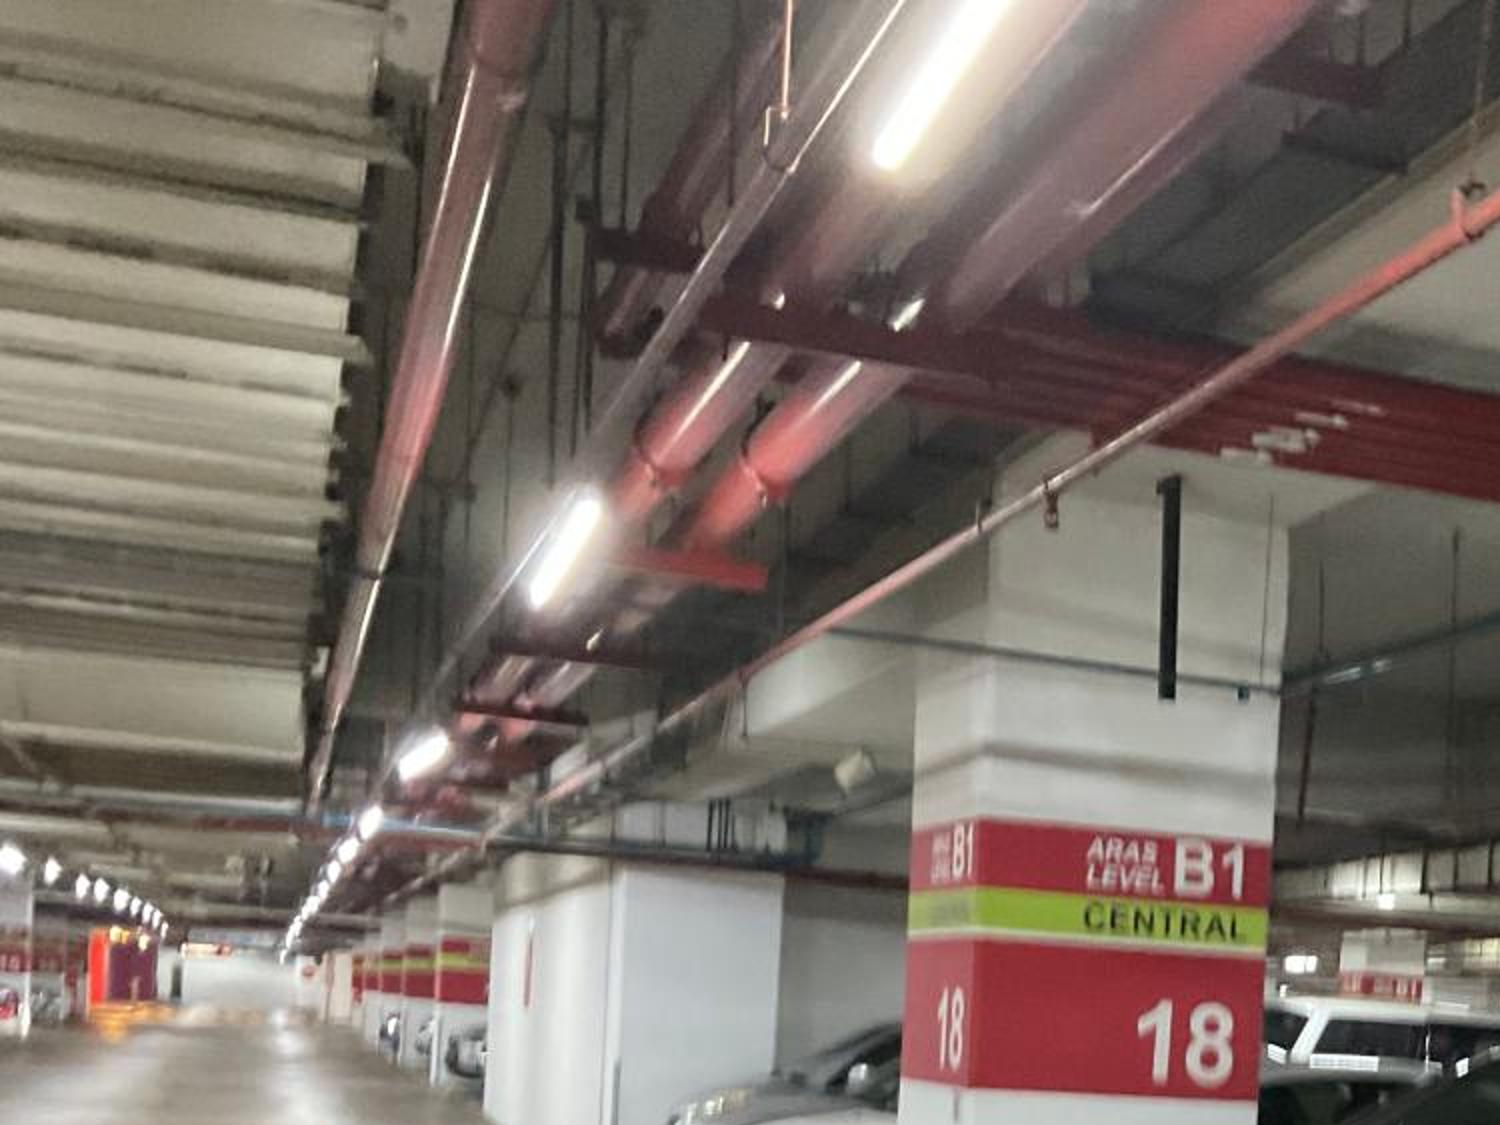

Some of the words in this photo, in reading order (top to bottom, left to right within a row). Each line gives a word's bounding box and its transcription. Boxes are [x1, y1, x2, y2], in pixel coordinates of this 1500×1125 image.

[1087, 863, 1165, 895] LEVEL
[1174, 837, 1245, 900] B1
[1084, 904, 1243, 942] CENTRAL
[937, 986, 965, 1072] 18
[1137, 999, 1234, 1088] 18
